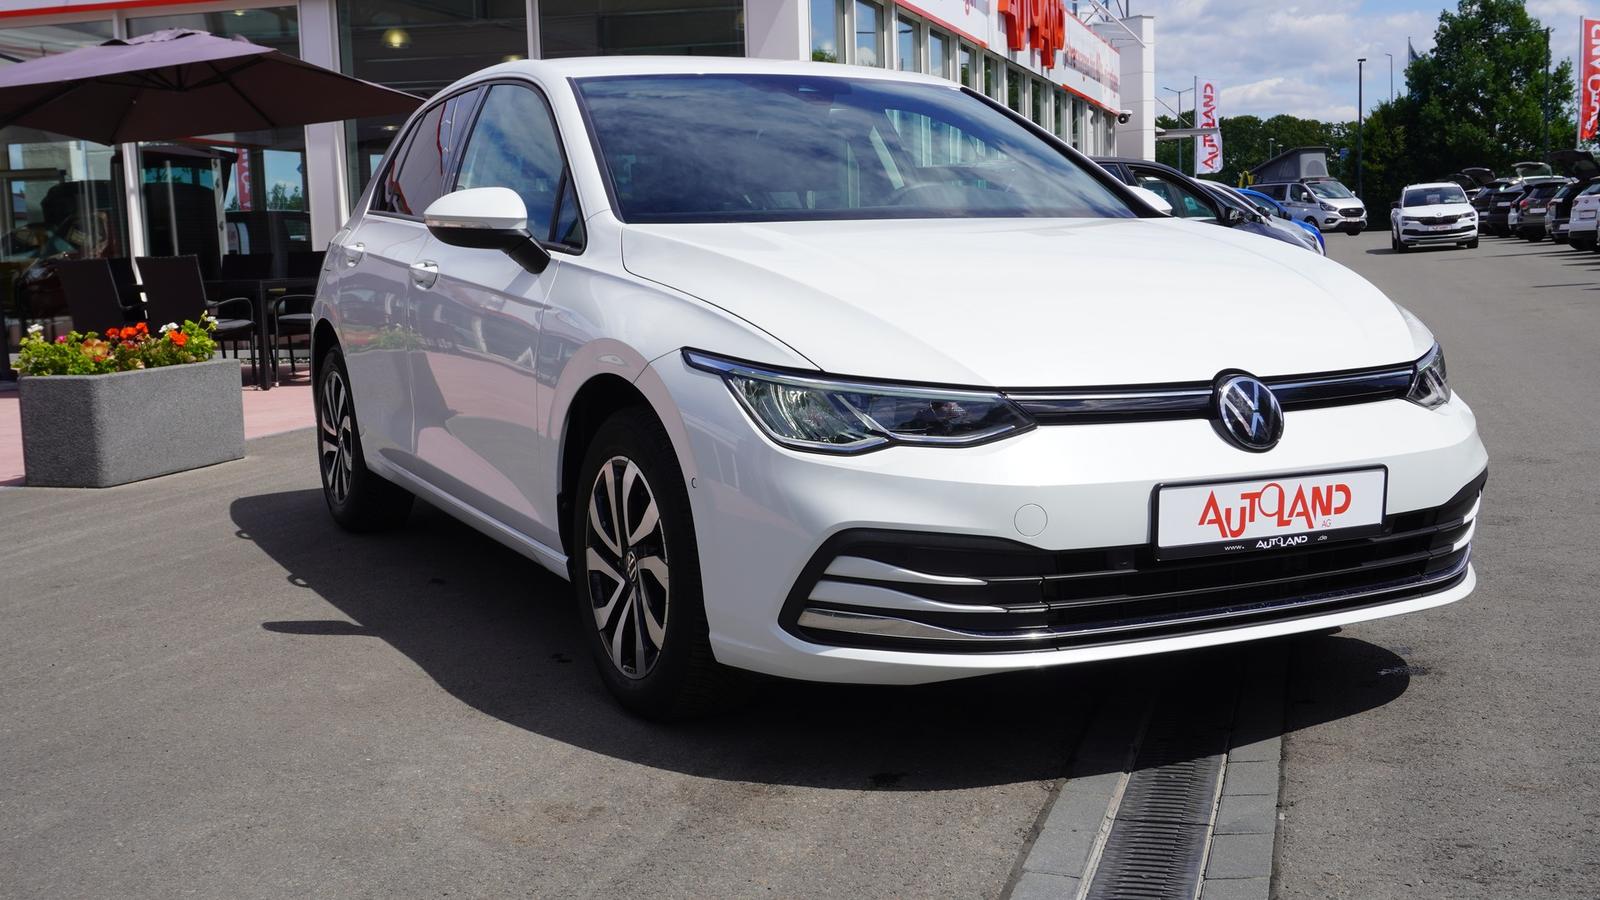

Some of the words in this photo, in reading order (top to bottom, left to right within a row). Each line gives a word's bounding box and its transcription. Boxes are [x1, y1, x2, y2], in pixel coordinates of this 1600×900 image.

[1198, 483, 1352, 538] AUTOLAND
[1321, 518, 1332, 528] AG
[1255, 536, 1308, 549] AUTOLAND
